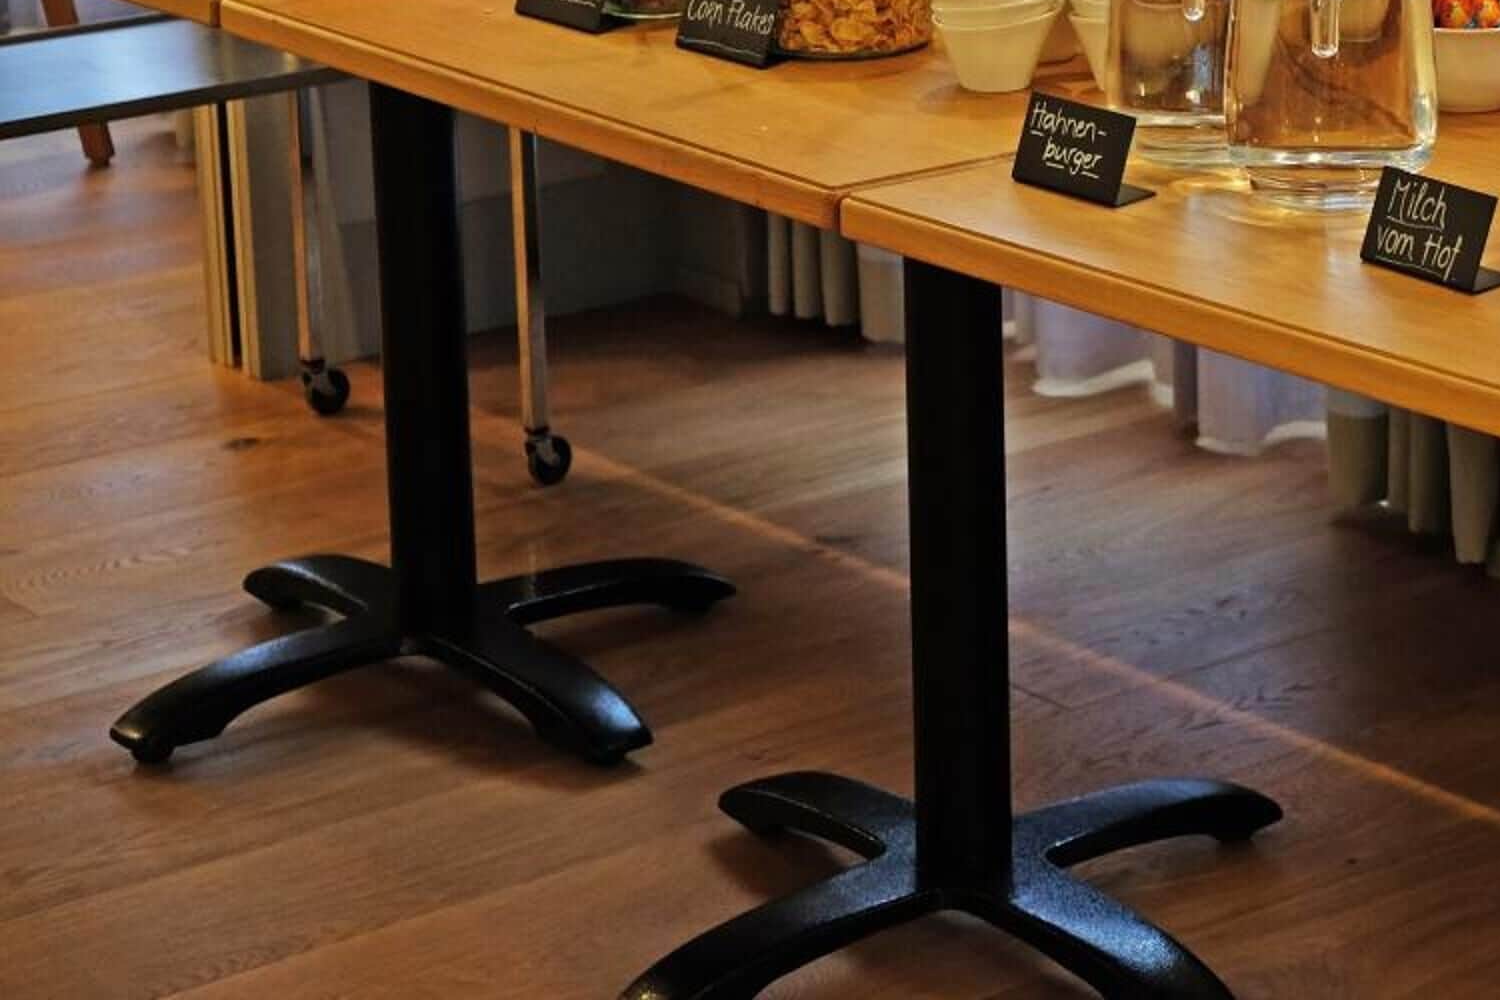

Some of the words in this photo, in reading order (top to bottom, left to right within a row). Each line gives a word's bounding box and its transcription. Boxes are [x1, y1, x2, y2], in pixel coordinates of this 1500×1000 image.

[726, 0, 775, 35] Flakes
[1030, 101, 1107, 144] Hahnen-
[1042, 136, 1103, 176] burger
[1387, 178, 1447, 230] Milch
[1377, 224, 1415, 261] vom
[1421, 234, 1464, 281] Hof
